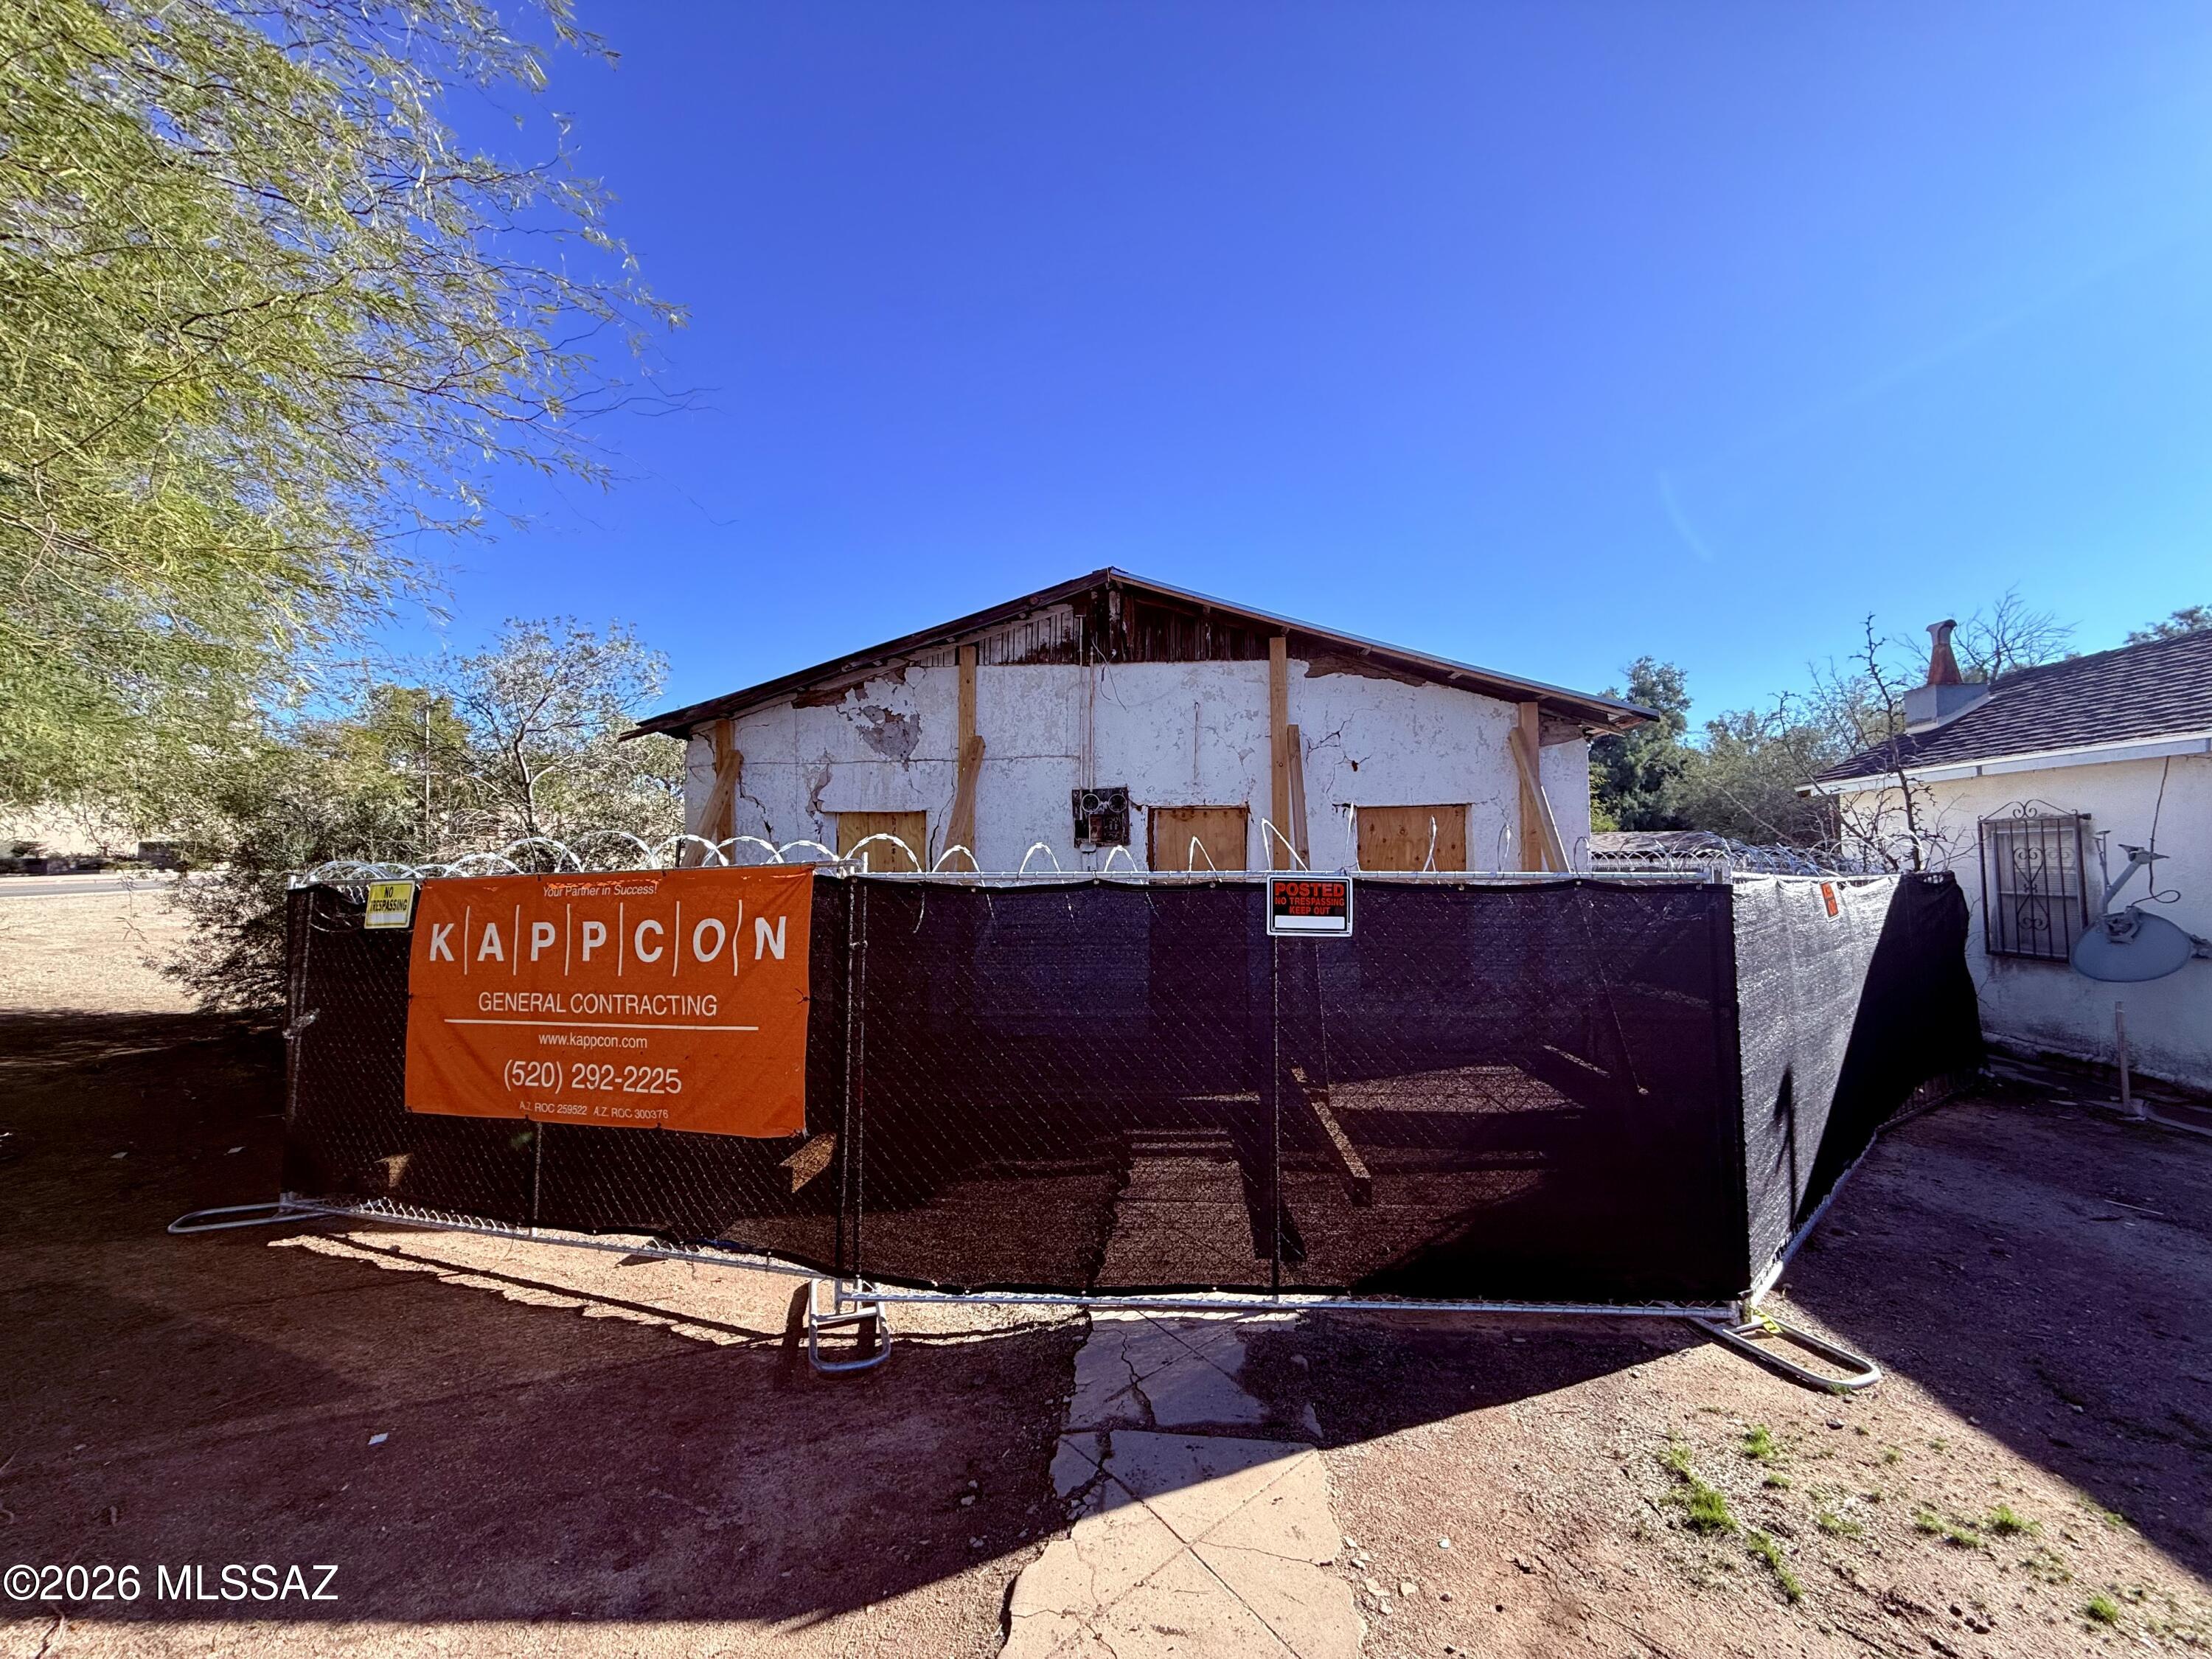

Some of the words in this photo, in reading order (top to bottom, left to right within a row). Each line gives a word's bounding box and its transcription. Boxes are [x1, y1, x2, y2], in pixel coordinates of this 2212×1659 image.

[383, 886, 394, 898] NO
[543, 886, 563, 897] Your
[565, 885, 599, 897] Partner
[613, 882, 658, 896] Success!
[1275, 883, 1344, 897] POSTED
[370, 899, 408, 912] TRESPASSING
[1275, 897, 1287, 905] NO
[1290, 897, 1345, 906] TRESPASSING
[1289, 906, 1311, 914] KEEP
[479, 992, 566, 1013] GENERAL
[570, 993, 717, 1016] CONTRACTING
[538, 1032, 647, 1049] www.kappcon.com
[504, 1060, 563, 1094] (520)
[571, 1063, 682, 1094] 292-2225
[535, 1102, 554, 1113] ROC
[557, 1104, 588, 1116] 259522
[611, 1107, 633, 1118] ROC
[634, 1109, 669, 1119] 300376
